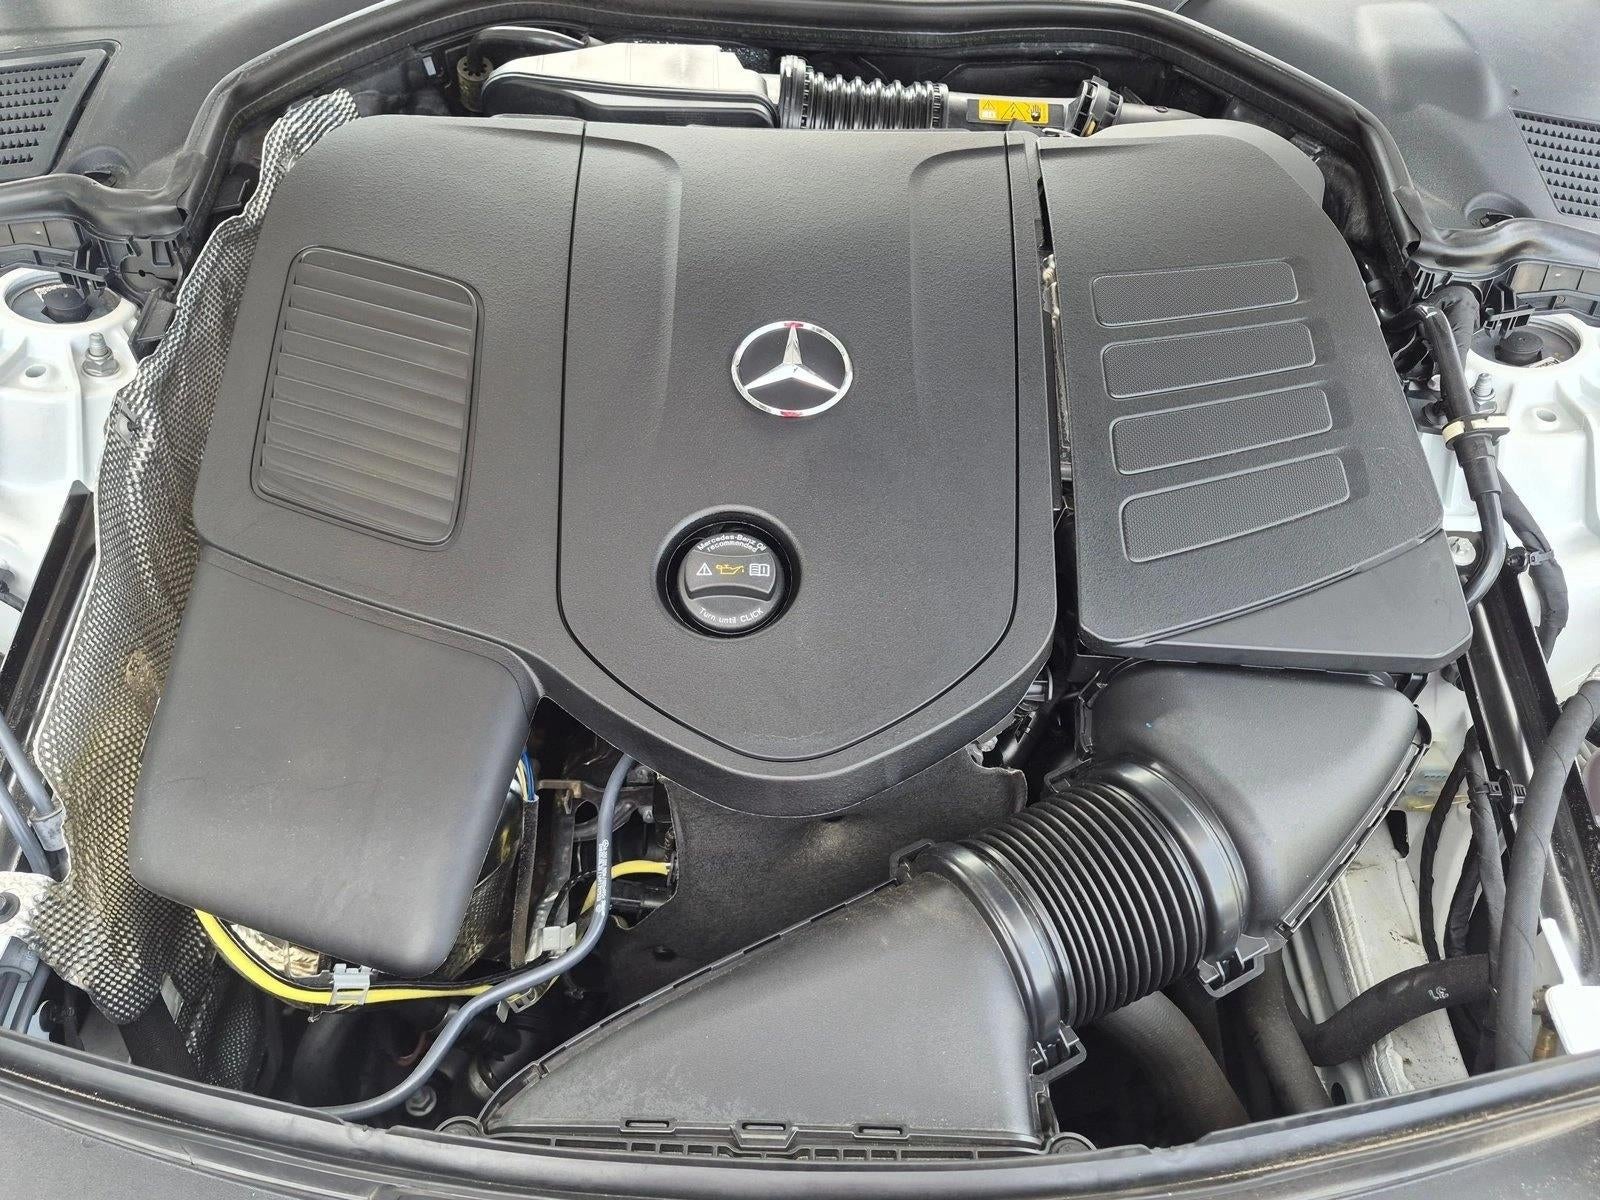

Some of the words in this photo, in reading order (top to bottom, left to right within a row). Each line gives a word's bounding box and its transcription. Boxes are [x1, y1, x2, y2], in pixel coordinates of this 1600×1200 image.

[697, 534, 756, 551] Mercedes-Benz
[756, 542, 767, 551] Oil
[707, 540, 758, 553] recommended
[699, 606, 716, 621] Turn
[740, 607, 764, 623] CLICK
